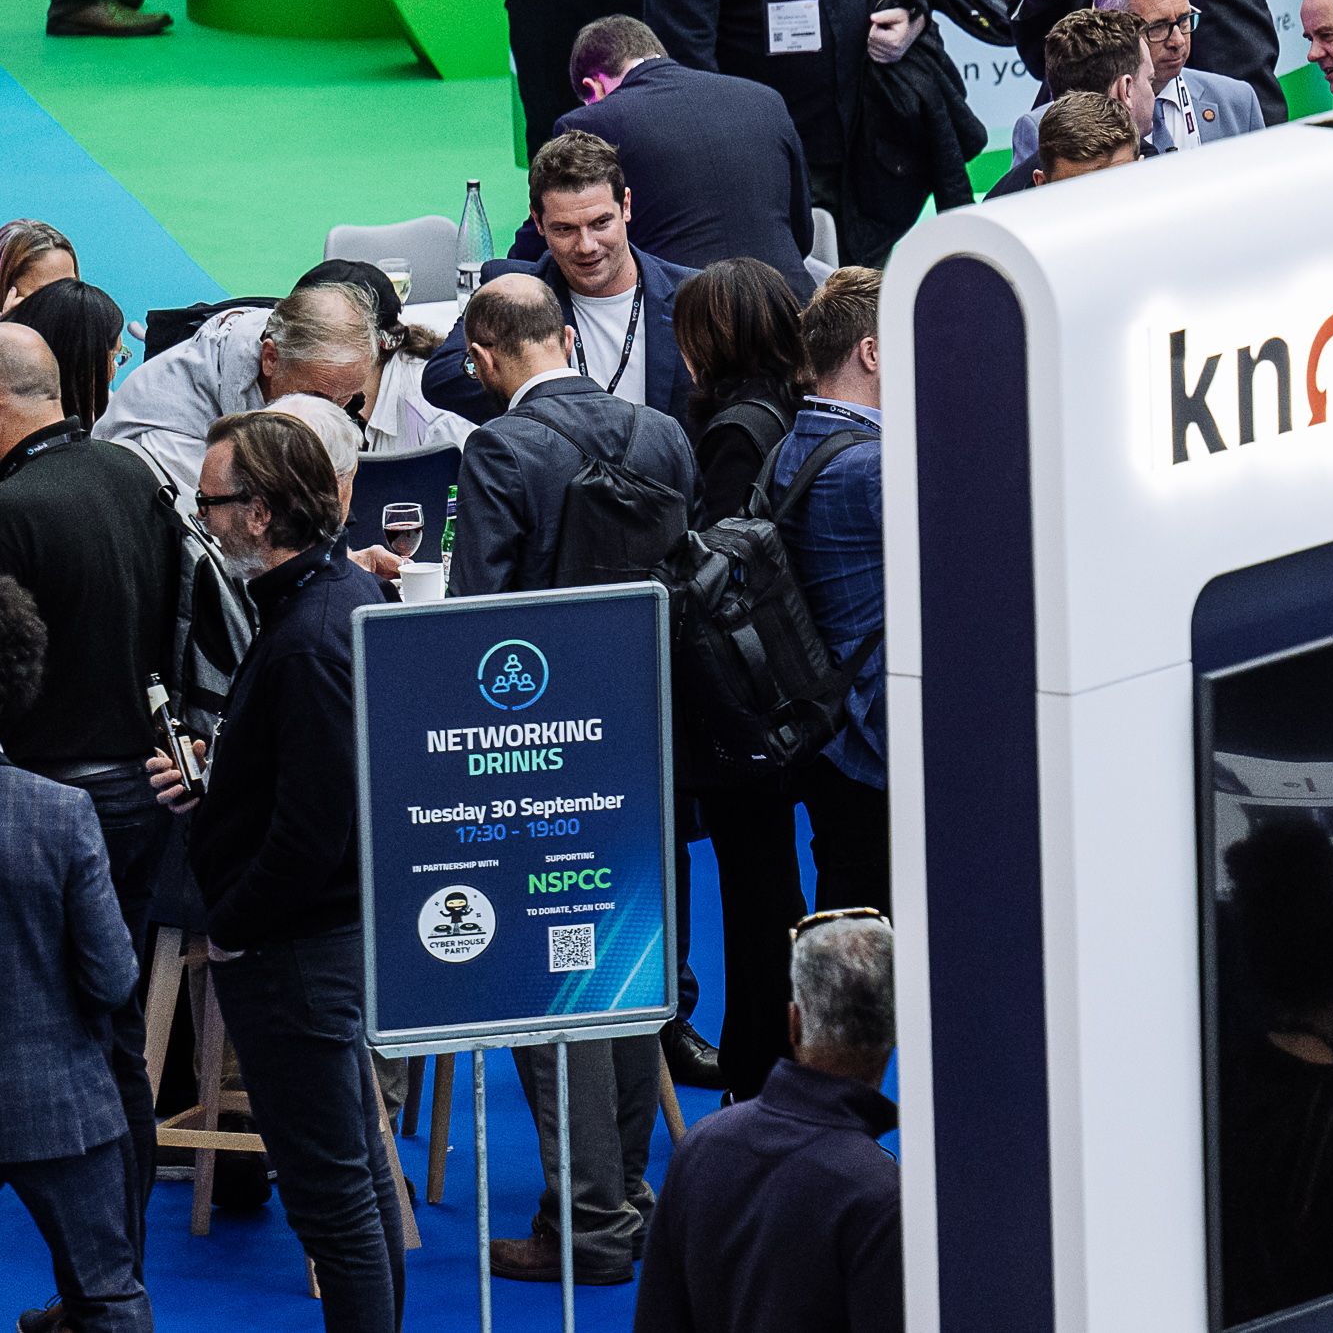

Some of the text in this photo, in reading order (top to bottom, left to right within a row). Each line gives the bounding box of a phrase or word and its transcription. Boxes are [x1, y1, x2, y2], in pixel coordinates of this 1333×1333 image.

[427, 718, 603, 754] NETWORKING
[468, 748, 565, 776] DRINKS
[408, 791, 625, 826] Tuesday 30 September
[456, 823, 507, 844] 17:30
[529, 818, 581, 839] 19:00
[412, 859, 500, 874] IN PARTNERSHIP WITH
[545, 851, 595, 864] SUPPORTING
[528, 868, 612, 895] NSPCC
[526, 901, 616, 916] TO DONATE, SCAN CODE
[429, 937, 486, 950] CYBER HOUSE
[444, 945, 471, 956] PARTY
